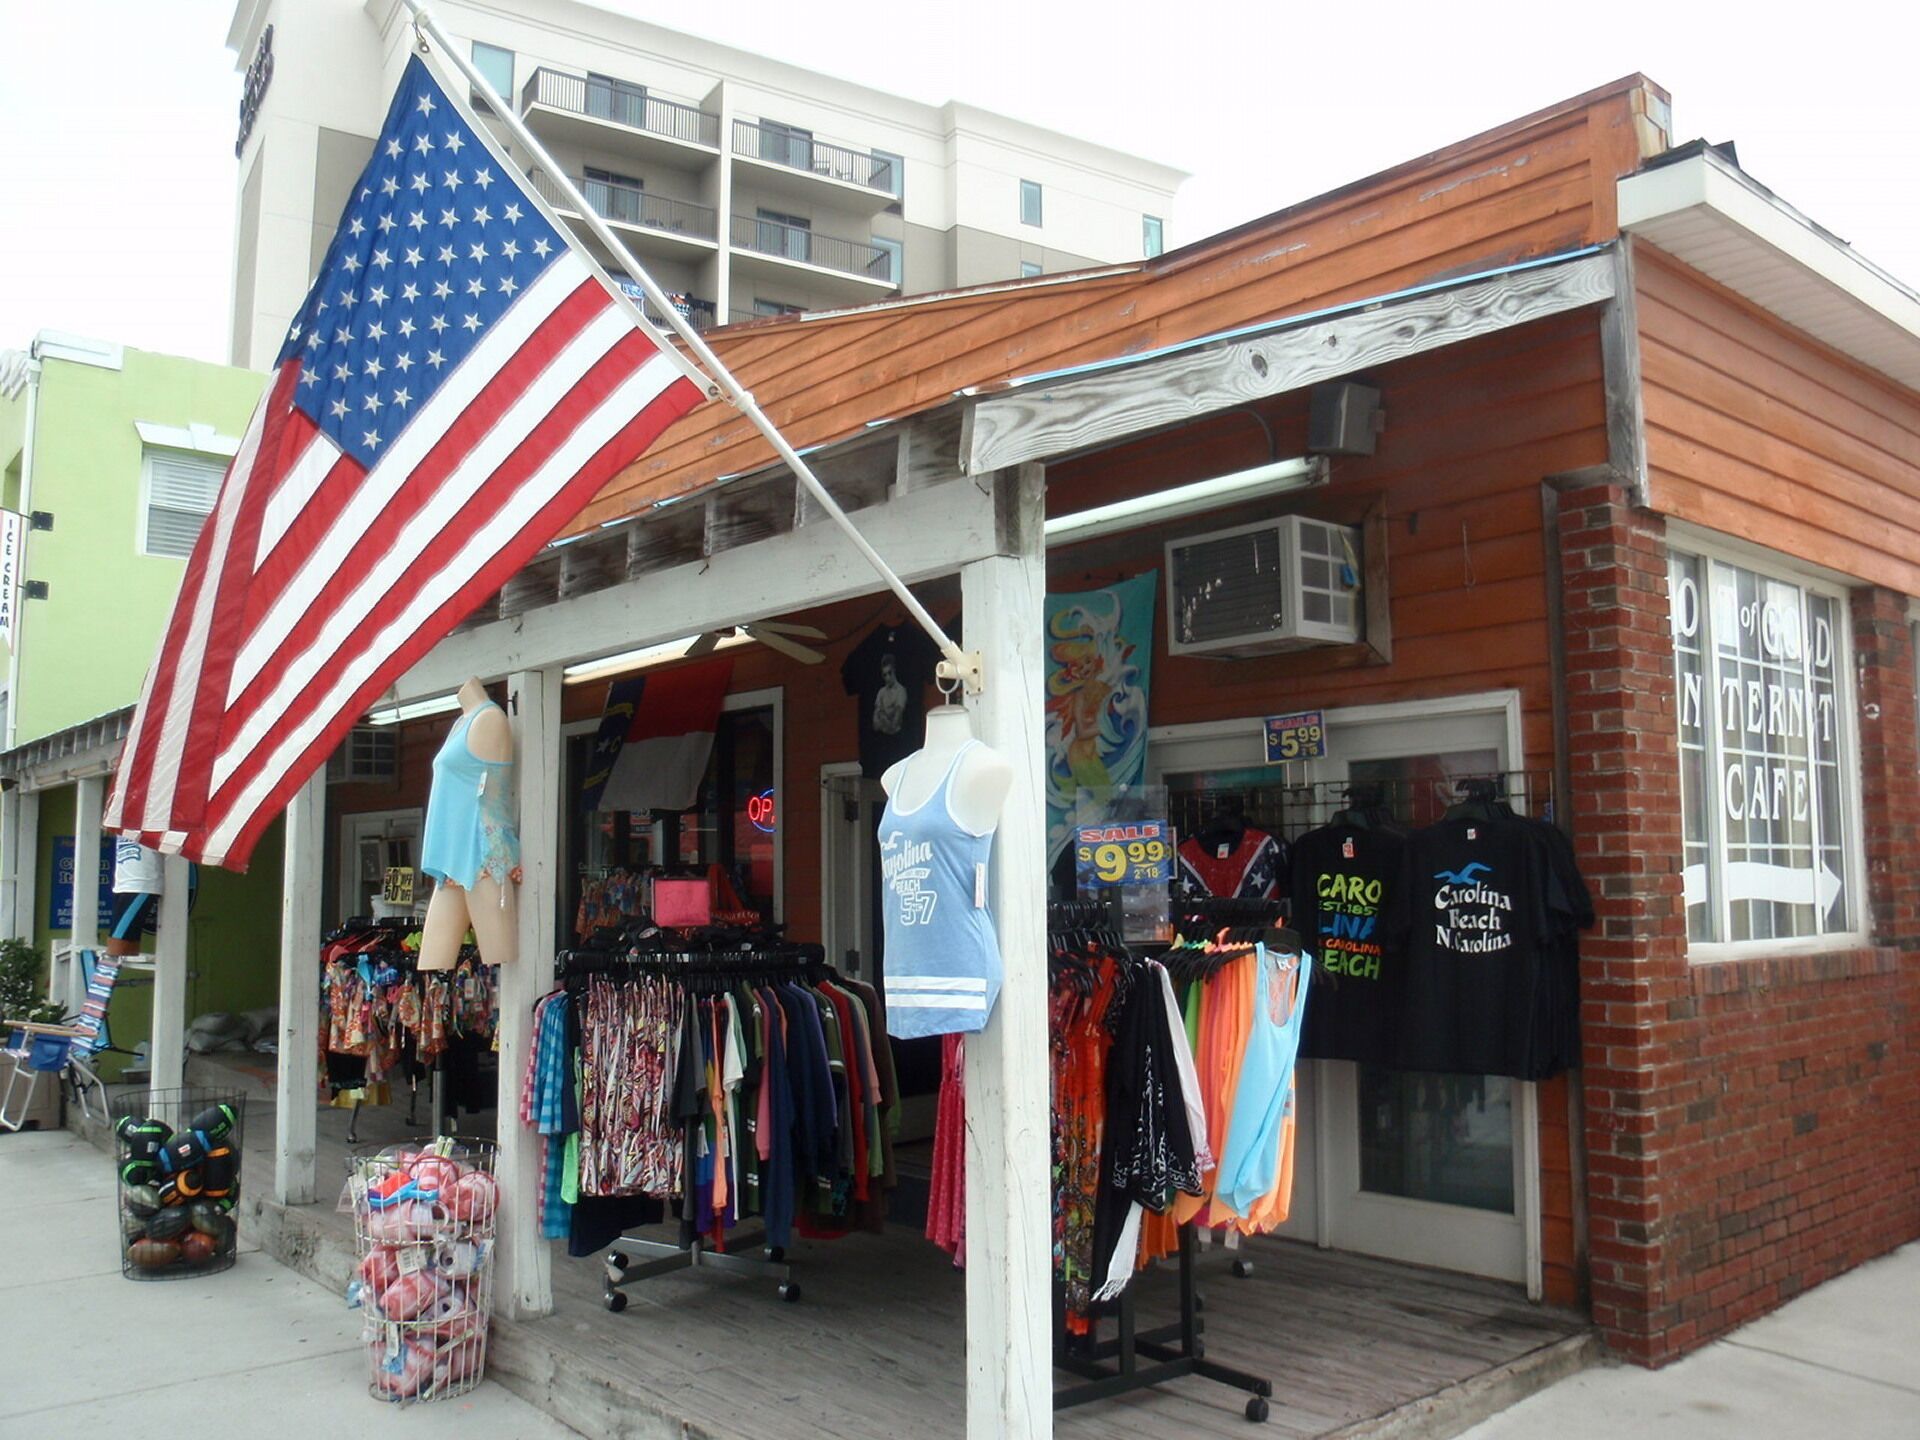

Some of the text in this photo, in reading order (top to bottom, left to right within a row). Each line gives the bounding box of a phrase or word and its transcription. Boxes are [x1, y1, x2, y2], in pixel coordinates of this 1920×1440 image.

[0, 519, 14, 628] ICE CREAM
[1741, 602, 1757, 637] of
[1682, 672, 1833, 742] NTERNT
[1726, 763, 1808, 822] CAFE
[1080, 825, 1160, 842] SALE
[1317, 873, 1382, 906] CARO
[1435, 880, 1512, 911] Carolina
[900, 890, 937, 926] 57
[1449, 907, 1501, 930] Beach
[1320, 949, 1381, 980] EACH
